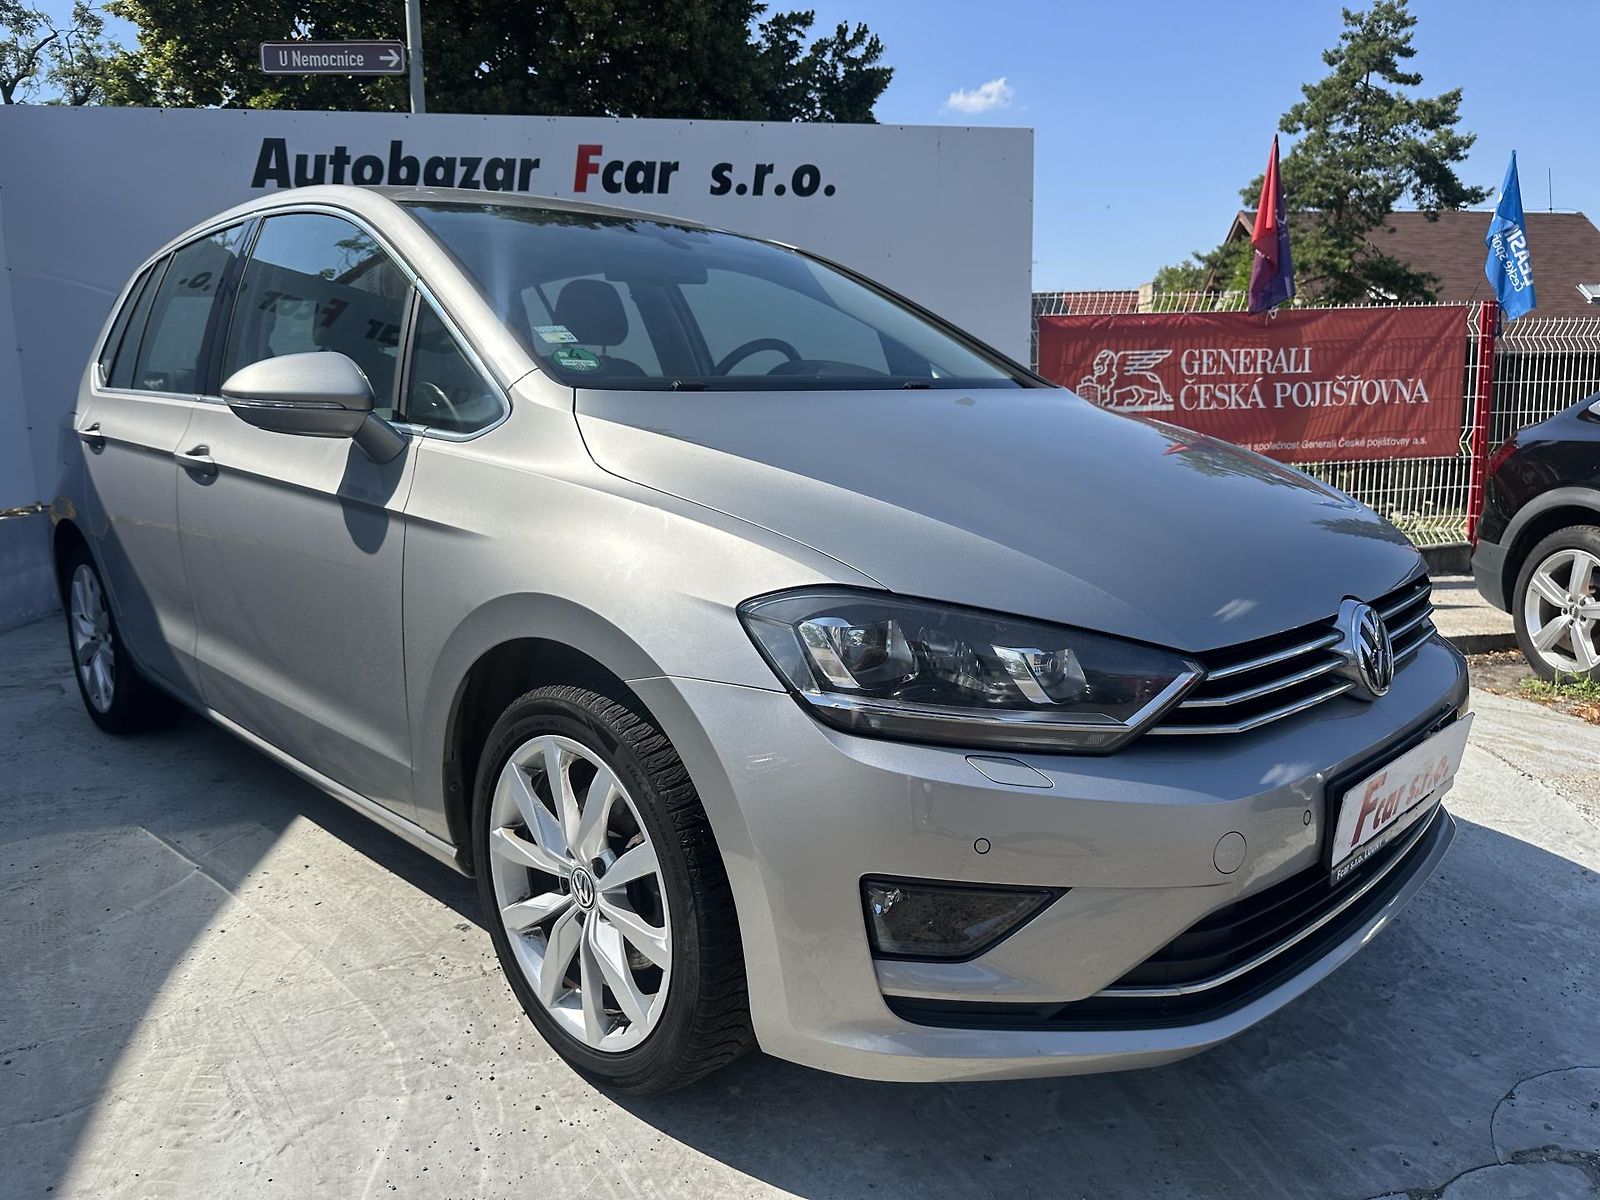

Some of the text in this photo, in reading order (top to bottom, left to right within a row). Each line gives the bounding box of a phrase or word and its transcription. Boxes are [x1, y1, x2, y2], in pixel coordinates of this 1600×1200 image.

[279, 50, 365, 67] U Nemocnice
[251, 137, 836, 197] Autobazar Fcar s.r.o.
[1180, 347, 1312, 376] GENERALI
[1179, 374, 1430, 411] ČESKÁ POJIŠŤOVNA
[1253, 441, 1300, 453] společnost
[1301, 440, 1337, 450] Generali
[1338, 436, 1365, 448] České
[1350, 771, 1407, 847] Fcar
